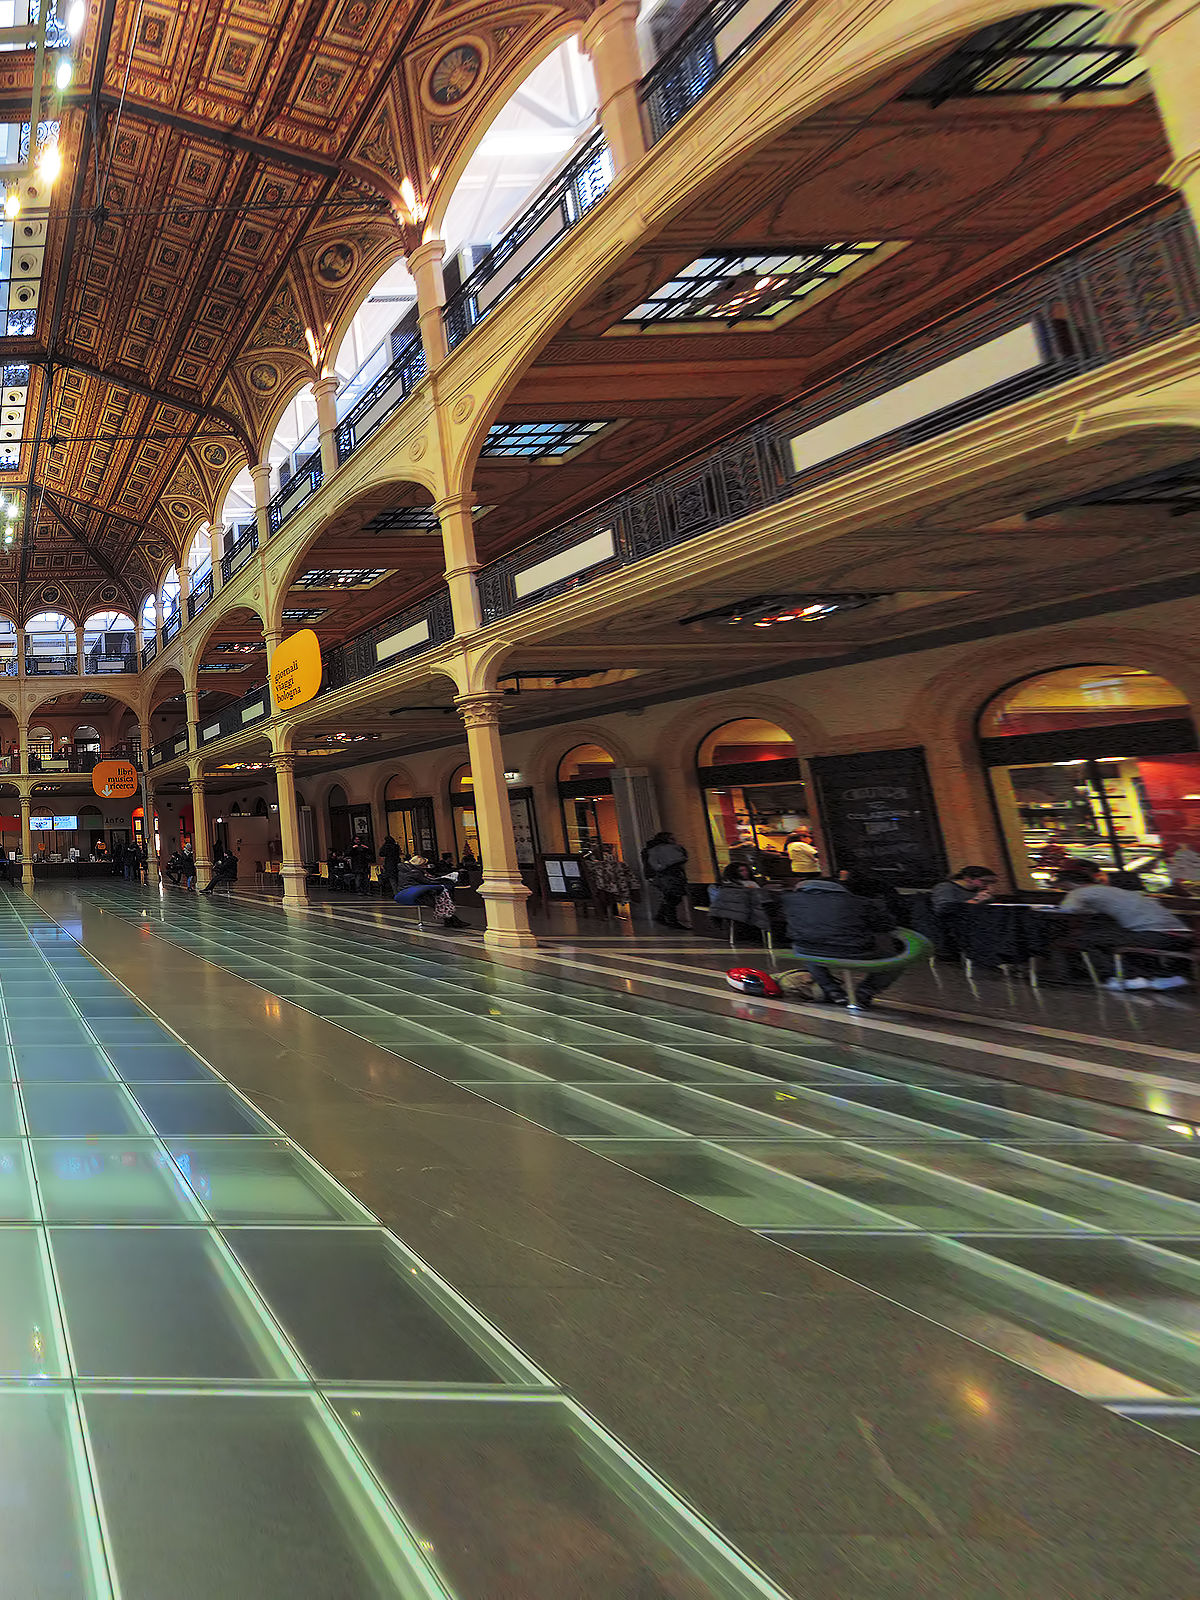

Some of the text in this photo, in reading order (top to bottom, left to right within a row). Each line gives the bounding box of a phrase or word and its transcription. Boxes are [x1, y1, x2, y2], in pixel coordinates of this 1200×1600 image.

[275, 660, 298, 684] giornali
[275, 675, 294, 692] viaggi
[277, 686, 301, 703] bologna
